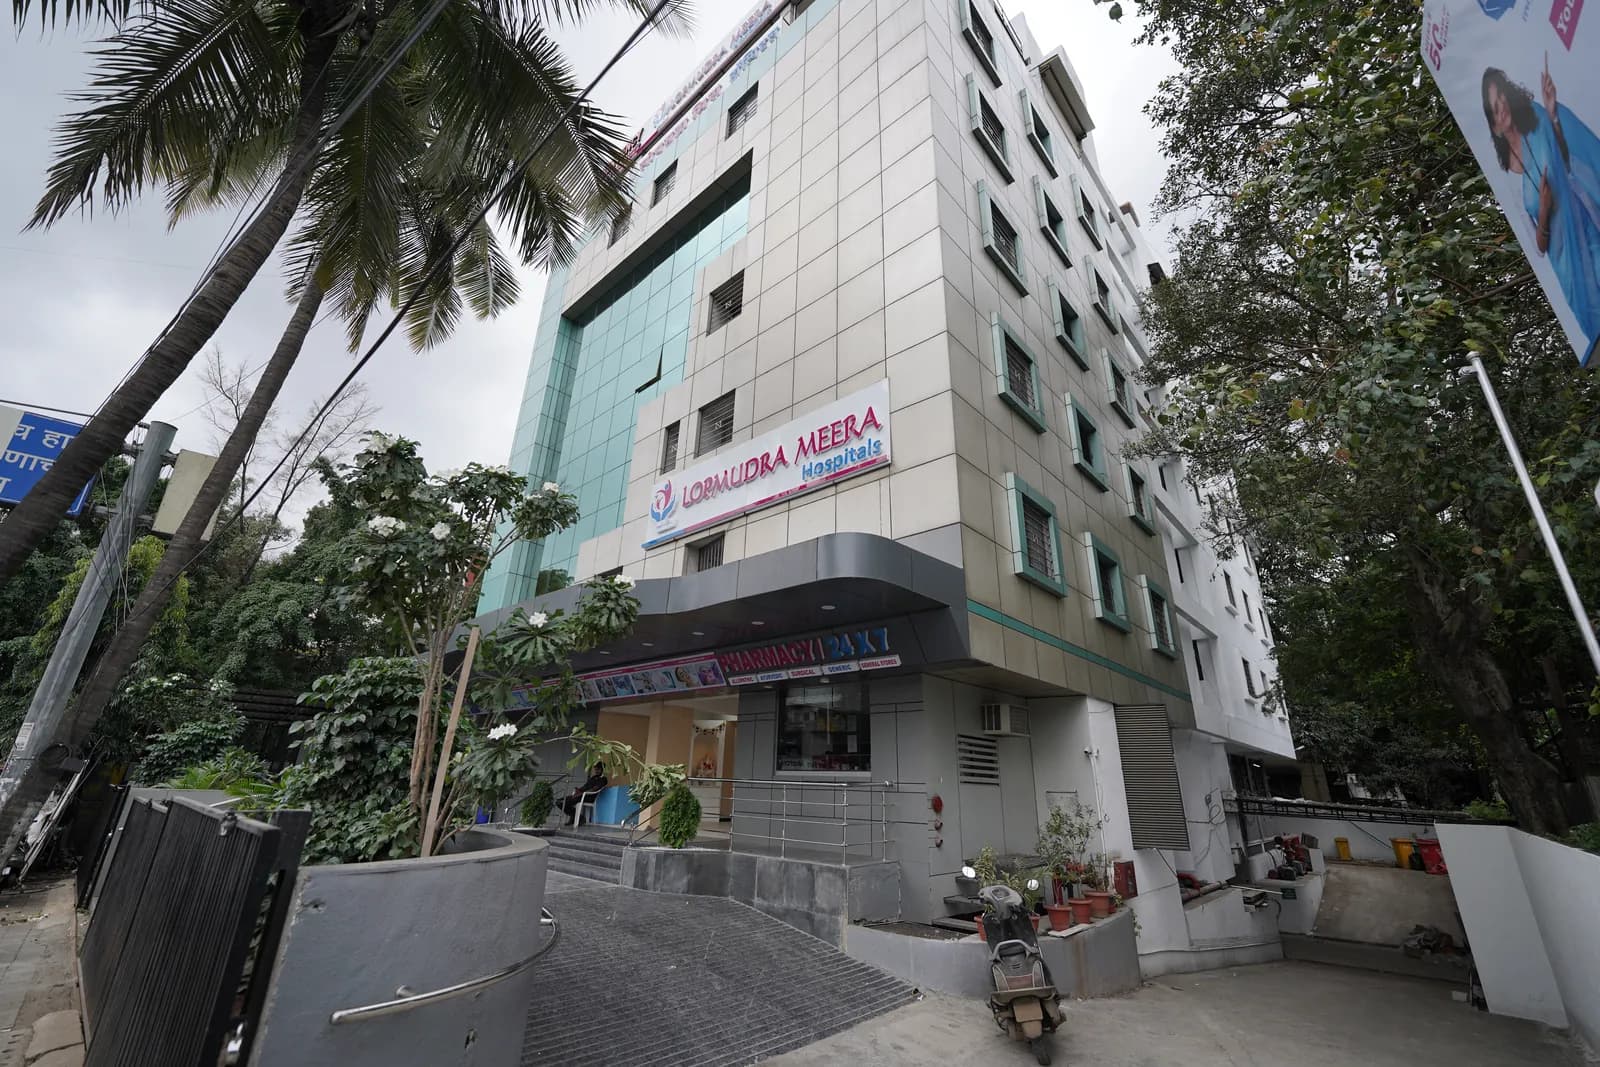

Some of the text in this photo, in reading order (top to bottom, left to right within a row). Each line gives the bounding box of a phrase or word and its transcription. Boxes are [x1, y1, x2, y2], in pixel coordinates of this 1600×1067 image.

[794, 406, 883, 465] MEERA
[801, 437, 883, 482] Hospitals
[719, 639, 815, 673] PHARMACY
[827, 663, 853, 673] GENERIC
